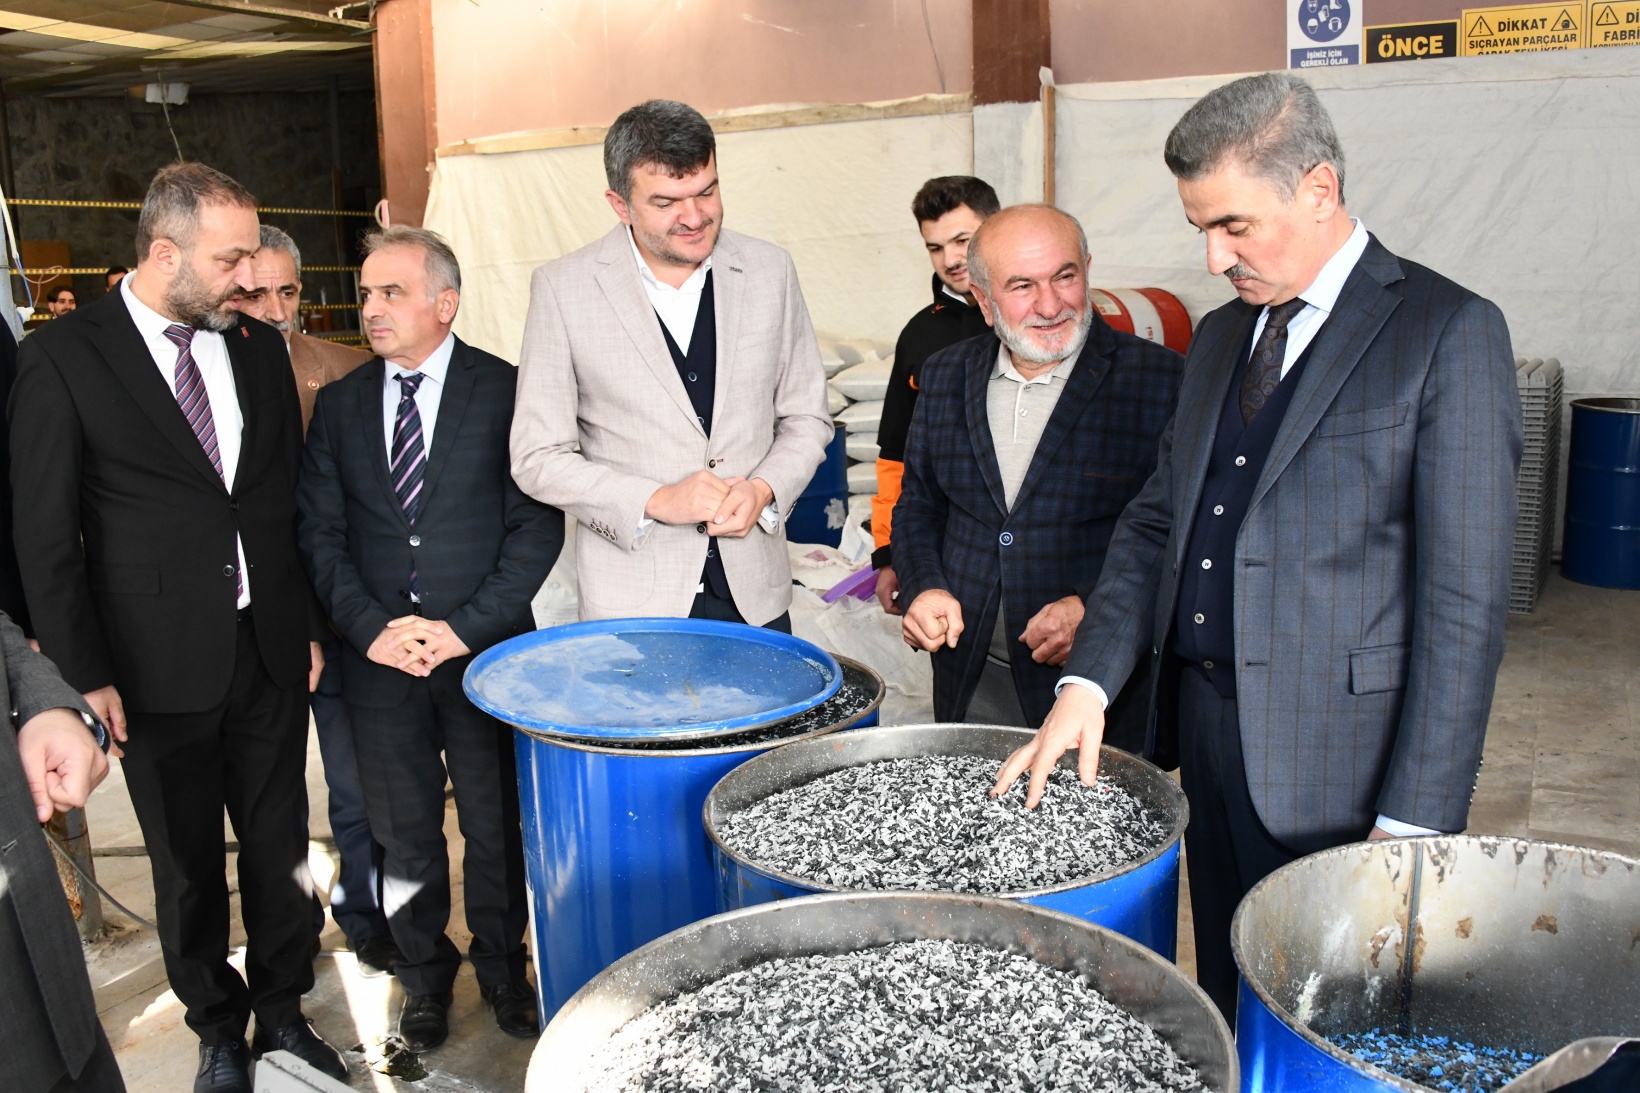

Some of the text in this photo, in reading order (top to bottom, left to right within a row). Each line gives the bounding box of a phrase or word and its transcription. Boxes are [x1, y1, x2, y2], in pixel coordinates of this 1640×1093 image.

[1498, 18, 1547, 32] DİKKAT
[1378, 34, 1443, 58] ÖNCE
[1469, 37, 1520, 51] SIÇRAYAN
[1522, 33, 1577, 47] PARÇALAR
[1300, 57, 1348, 67] GEREKLİ OLAN
